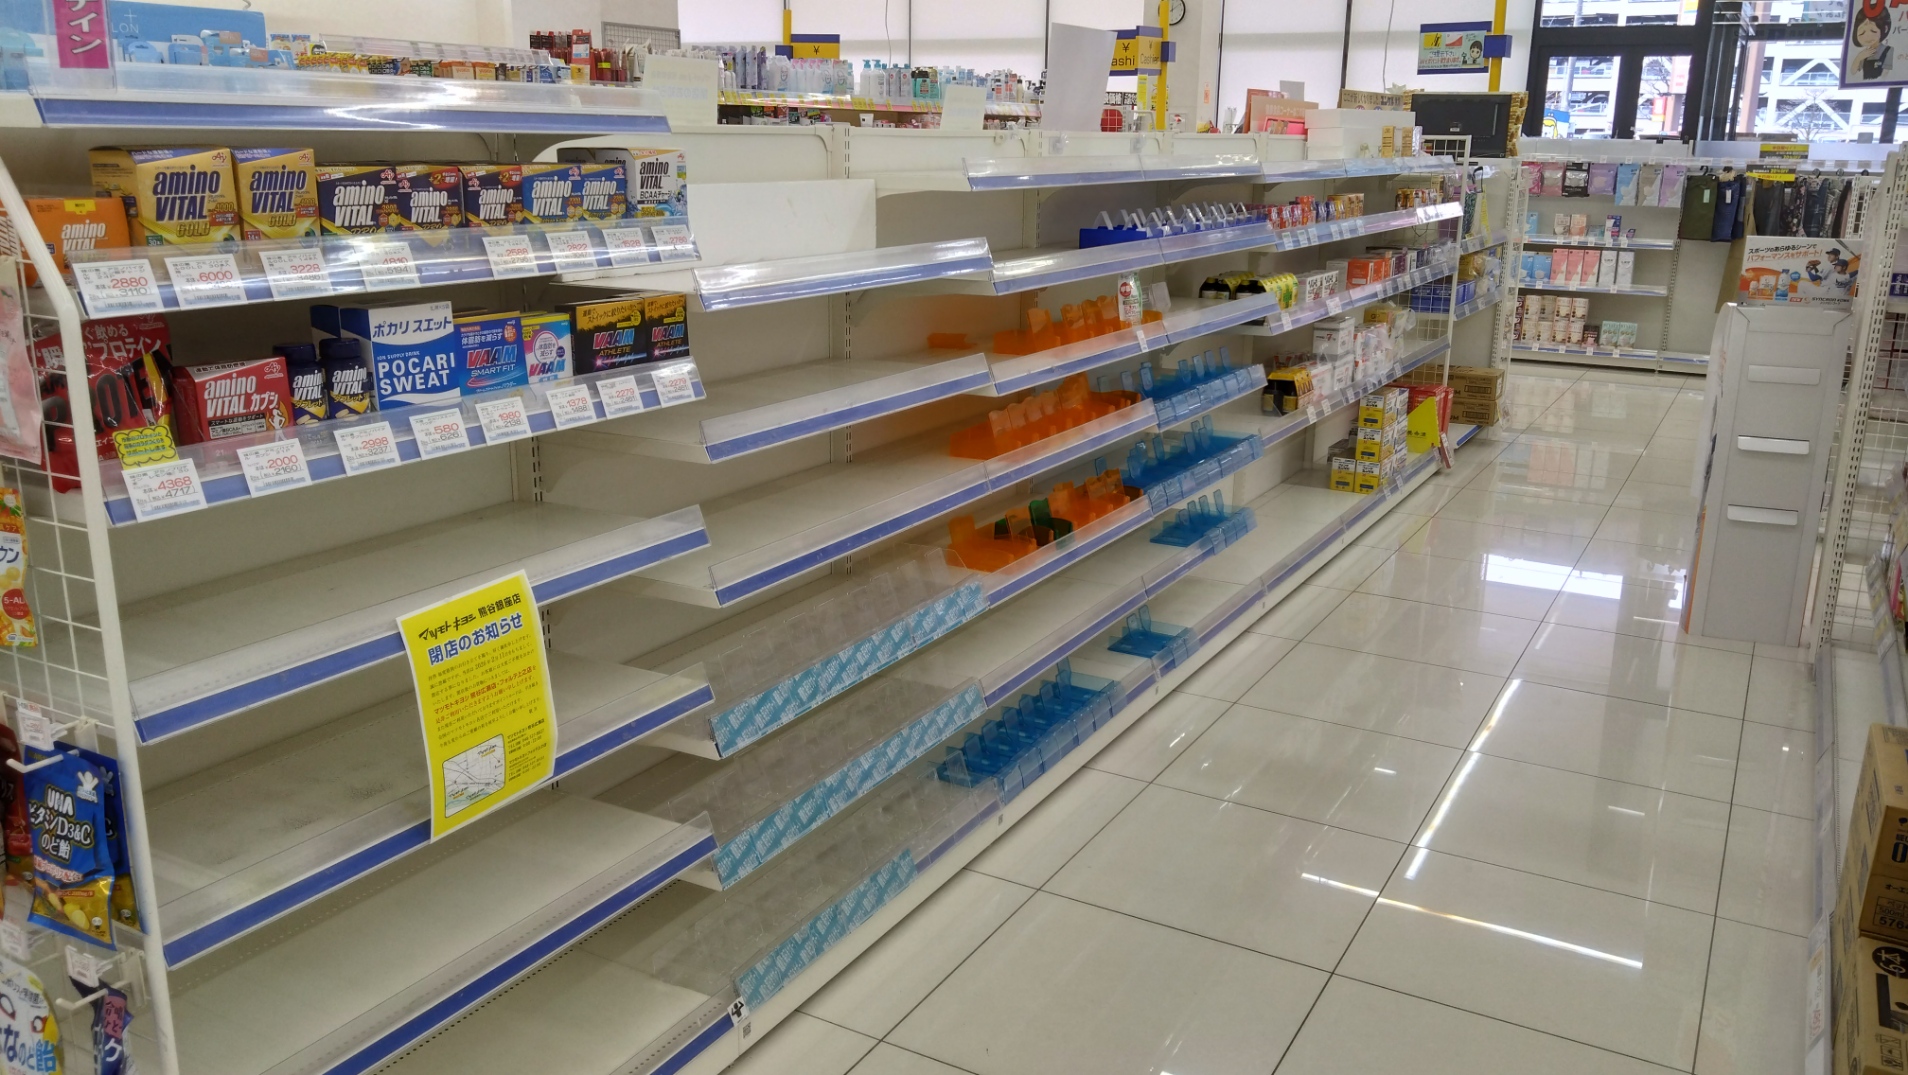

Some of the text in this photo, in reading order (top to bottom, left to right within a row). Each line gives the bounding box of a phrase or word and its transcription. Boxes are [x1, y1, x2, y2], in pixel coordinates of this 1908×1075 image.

[639, 157, 670, 176] amino
[152, 164, 221, 196] amino
[250, 164, 308, 191] amino
[640, 175, 663, 190] VITAL
[333, 180, 385, 206] amino
[532, 175, 572, 199] amino
[583, 177, 617, 196] amino
[251, 191, 295, 214] VITAL
[410, 187, 448, 208] amino
[479, 185, 514, 205] amino
[583, 195, 609, 211] VITAL
[154, 195, 209, 222] VITAL
[411, 207, 442, 223] VITAL
[479, 204, 507, 220] VITAL
[532, 198, 564, 217] VITAL
[268, 214, 297, 227] GOLD
[334, 205, 374, 227] VITAL
[61, 219, 107, 239] amino
[175, 222, 211, 237] GOLD
[505, 248, 529, 257] 2588
[199, 271, 233, 282] 6000
[290, 263, 321, 275] 3228
[110, 276, 148, 289] 2880
[372, 316, 452, 339] ポカリ スエット
[651, 323, 685, 341] VAAM
[461, 332, 503, 345] 体脂肪を減らす
[592, 328, 635, 350] VAAM
[656, 339, 682, 348] ATHLETE
[467, 344, 518, 369] VAAM
[598, 346, 632, 357] ATHLETE
[331, 365, 368, 382] amino
[377, 352, 456, 379] POCARI
[471, 363, 516, 378] SMART FIT
[528, 359, 567, 377] VAAM
[204, 373, 257, 400] amino
[332, 380, 364, 396] VITAL
[379, 371, 450, 396] SWEAT
[293, 385, 322, 401] VITAL
[615, 388, 635, 398] 2279
[205, 392, 279, 419] VITAL カプシ
[566, 397, 588, 407] 1378
[498, 410, 522, 421] 1980
[503, 418, 522, 428] 2138
[433, 422, 460, 434] 580
[361, 437, 390, 449] 2998
[368, 446, 389, 455] 3237
[267, 455, 299, 469] 2000
[275, 464, 299, 475] 2160
[157, 476, 193, 491] 4368
[165, 486, 192, 498] 4717
[418, 592, 522, 641] マツモトキヨシ 熊谷銀座店
[428, 612, 524, 666] 閉店のお知らせ
[46, 786, 74, 817] UHA
[41, 833, 71, 859] のど飴
